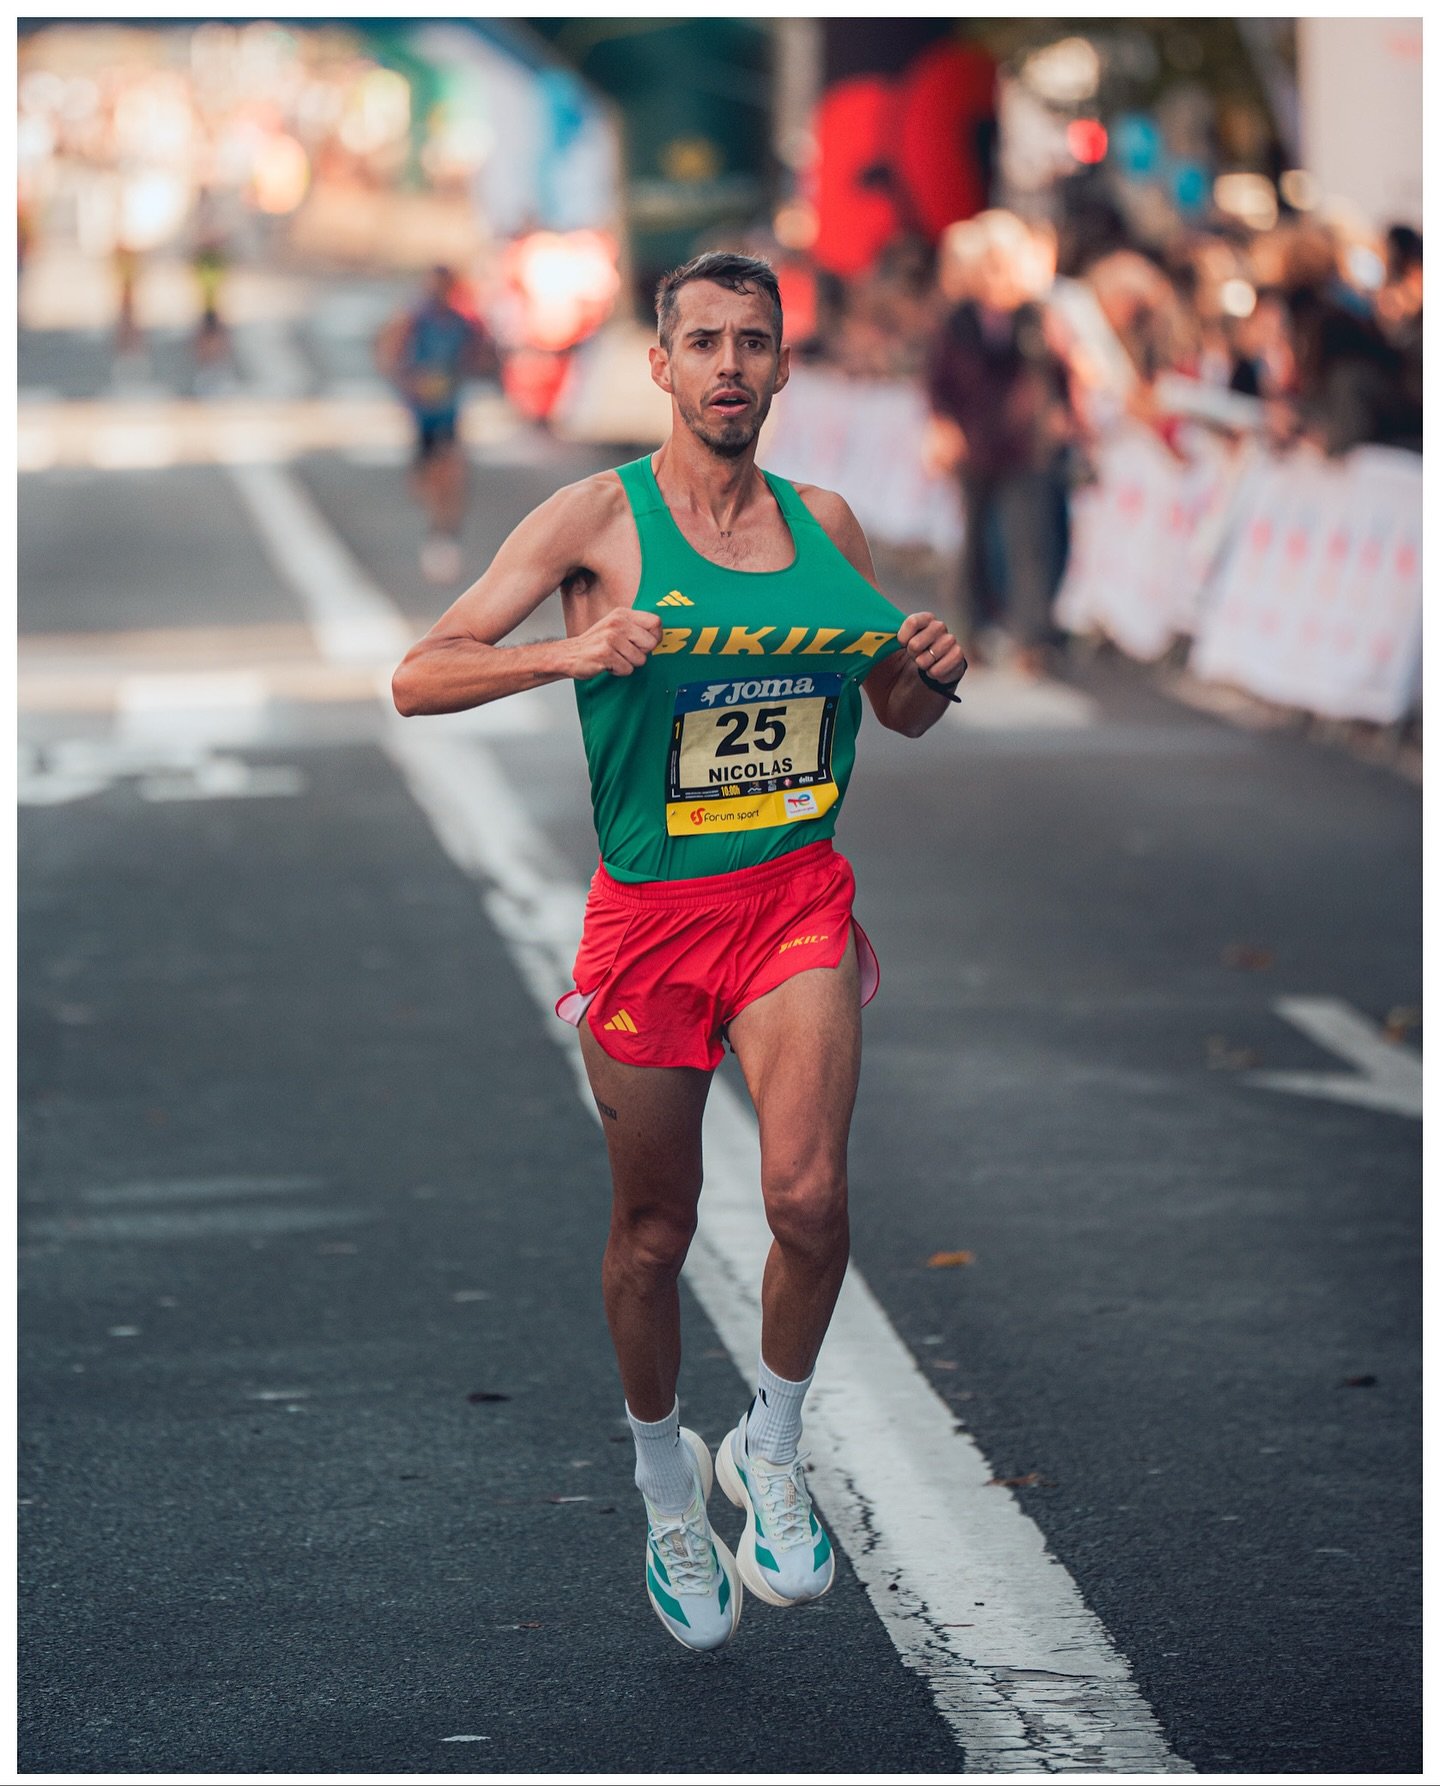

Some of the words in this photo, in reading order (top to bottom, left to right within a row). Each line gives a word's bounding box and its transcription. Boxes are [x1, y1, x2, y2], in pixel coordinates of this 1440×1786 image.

[651, 626, 897, 658] BIKILA
[715, 706, 787, 758] 25
[709, 757, 793, 783] NICOLAS
[737, 809, 759, 821] sport
